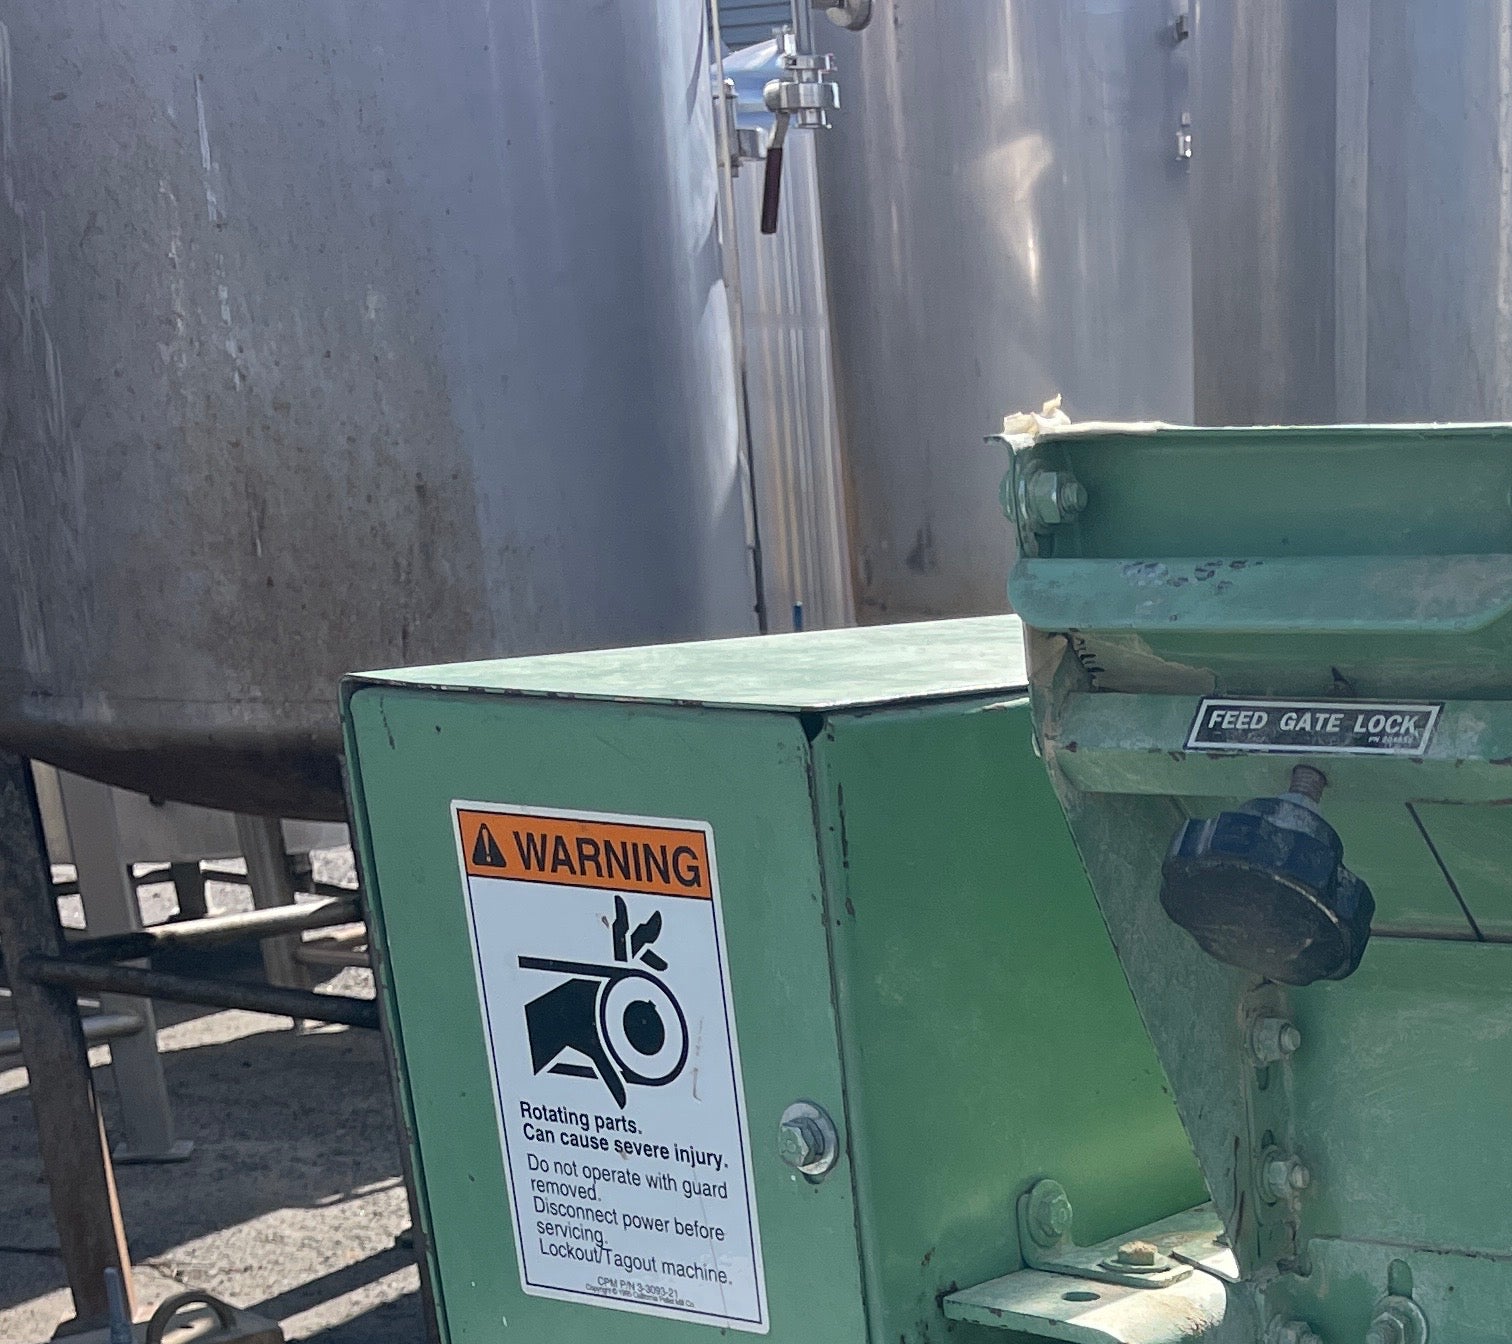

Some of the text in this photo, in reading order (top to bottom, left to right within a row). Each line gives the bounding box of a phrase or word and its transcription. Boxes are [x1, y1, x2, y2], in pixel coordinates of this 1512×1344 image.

[1207, 710, 1420, 735] FEED GATE LOCK
[513, 829, 702, 888] WARNING
[519, 1100, 643, 1135] Rotating parts.
[523, 1122, 729, 1171] Can cause severe injury.
[527, 1153, 729, 1200] Do not operate with guard
[530, 1178, 602, 1202] removed.
[533, 1196, 725, 1242] Disconnect power before
[536, 1219, 609, 1247] servicing.
[539, 1237, 733, 1285] Lockout/Tagout machine.
[597, 1275, 618, 1288] CPM
[620, 1279, 636, 1291] P/N
